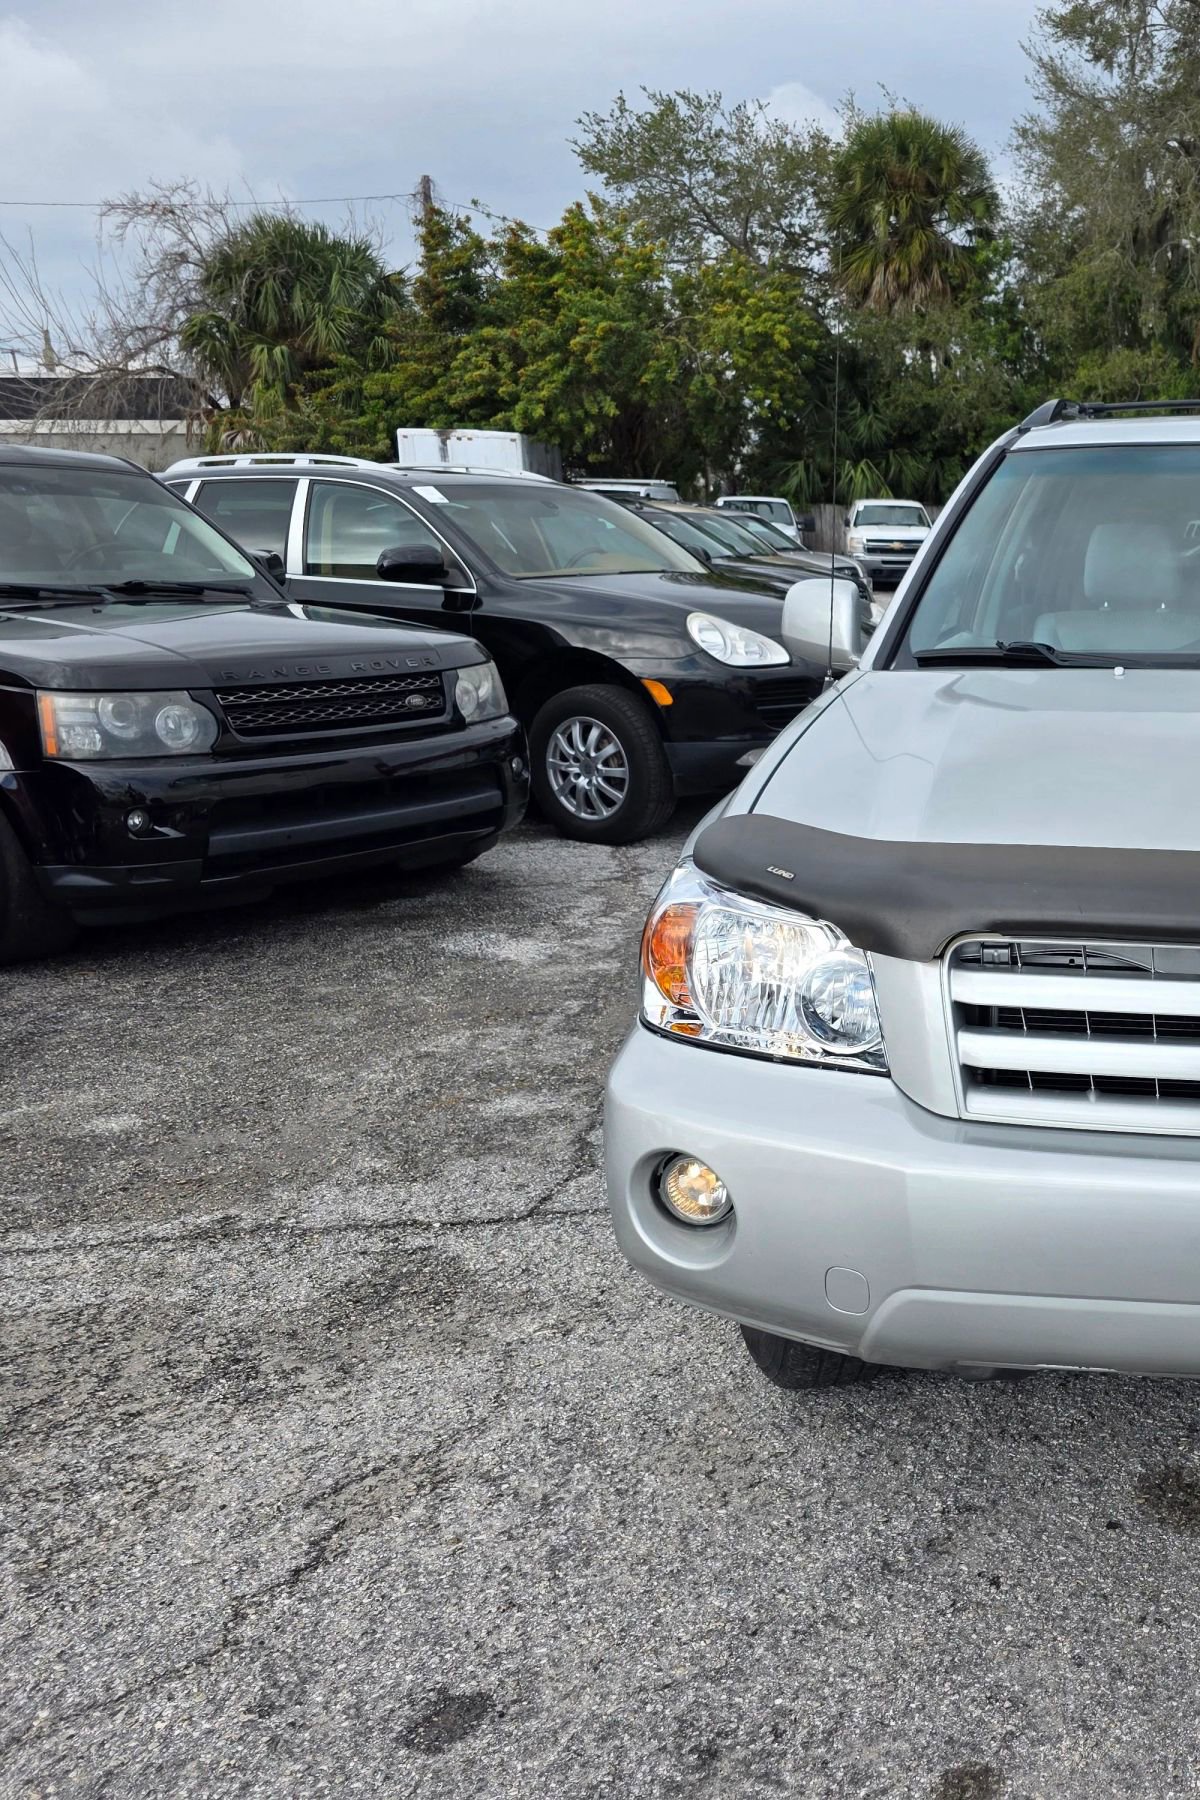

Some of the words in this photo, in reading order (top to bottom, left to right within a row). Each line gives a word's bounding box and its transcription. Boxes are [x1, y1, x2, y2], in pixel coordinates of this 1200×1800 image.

[221, 665, 331, 681] RANGE
[352, 656, 436, 673] ROVER
[766, 865, 795, 879] LUND
